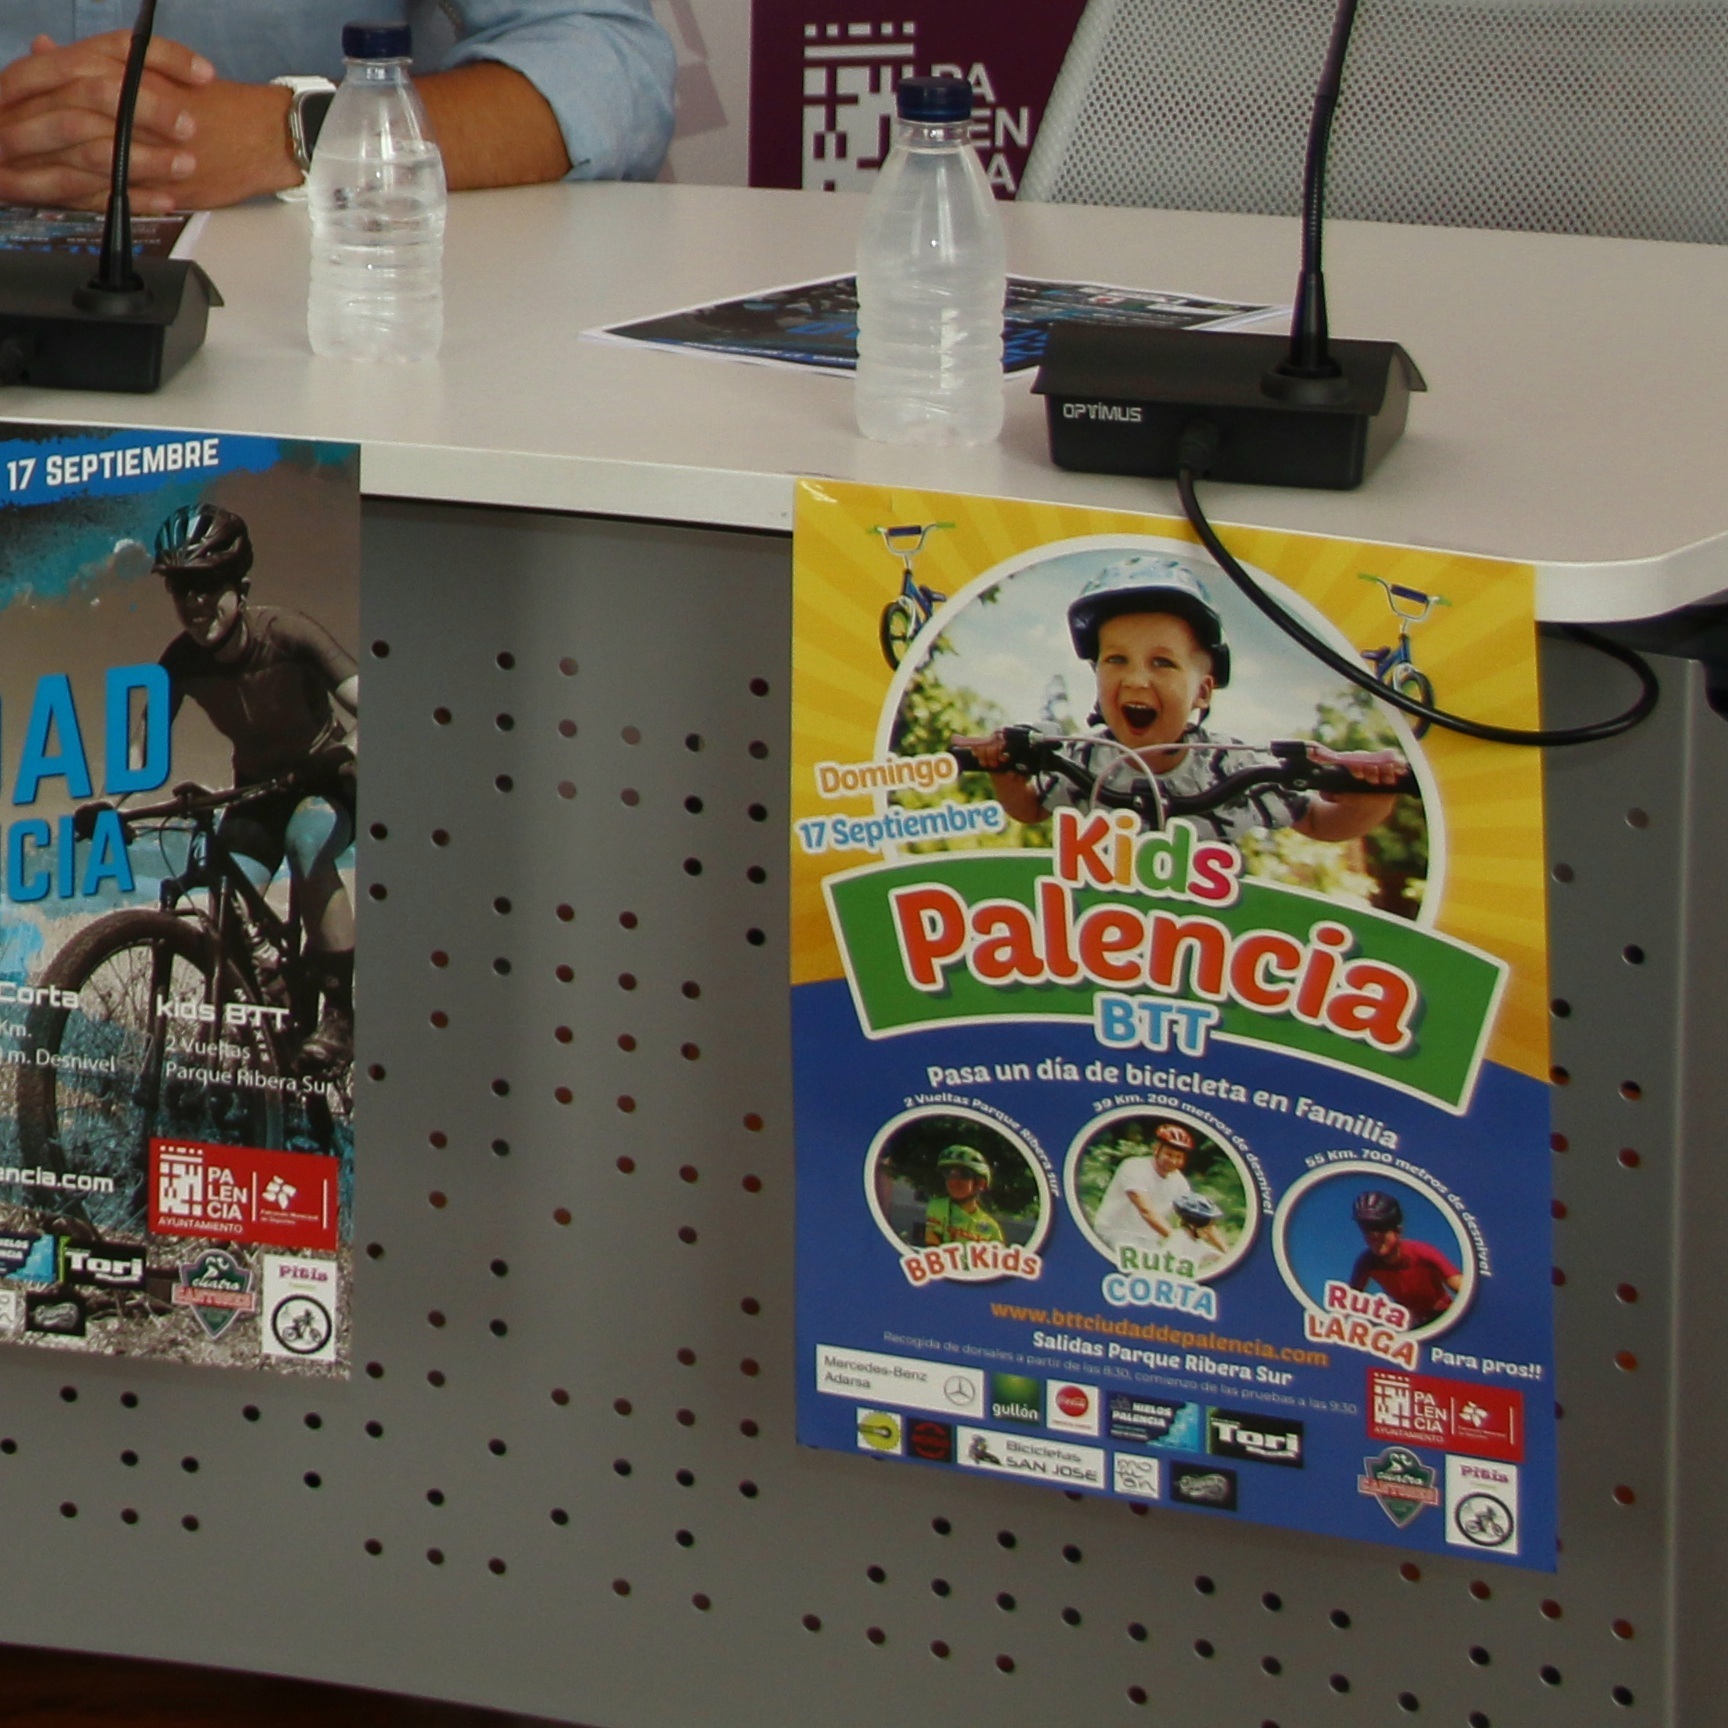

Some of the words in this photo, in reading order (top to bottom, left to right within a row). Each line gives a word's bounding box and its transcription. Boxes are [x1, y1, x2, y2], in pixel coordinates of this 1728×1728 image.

[1063, 402, 1142, 421] OPTIMUS
[7, 459, 36, 491] 17
[46, 439, 220, 487] SEPTIEMBRE
[820, 756, 953, 800] Domingo
[799, 825, 826, 849] 17
[832, 806, 999, 849] Septiembre
[1059, 814, 1236, 899] Kids
[895, 884, 1410, 1046] Palencia
[156, 993, 215, 1022] kids
[226, 1003, 290, 1029] BTT
[1103, 1003, 1211, 1051] BTT
[36, 1049, 115, 1072] Desnivel
[166, 1061, 232, 1088] Parque
[237, 1071, 296, 1092] Ribera
[927, 1066, 990, 1088] Pasa
[995, 1064, 1030, 1080] un
[1038, 1059, 1080, 1082] día
[1085, 1062, 1118, 1083] de
[1126, 1064, 1246, 1101] bicicleta
[1253, 1089, 1287, 1111] en
[1295, 1097, 1399, 1149] Familia
[208, 1167, 234, 1185] PA
[207, 1185, 247, 1204] LEN
[207, 1202, 242, 1220] CIA
[158, 1217, 243, 1234] AYUNTAMIENTO
[905, 1249, 960, 1282] BBT
[971, 1246, 1038, 1276] Kids
[1120, 1246, 1195, 1277] Ruta
[1106, 1279, 1215, 1315] CORTA
[1328, 1284, 1406, 1327] Ruta
[1308, 1314, 1417, 1366] LARGA
[1033, 1332, 1103, 1358] Salidas
[1109, 1342, 1181, 1372] Parque
[1186, 1351, 1252, 1380] Ribera
[1256, 1363, 1292, 1386] Sur
[1431, 1347, 1478, 1370] Para
[1482, 1358, 1542, 1380] pros!!
[1414, 1406, 1445, 1420] LEN
[1414, 1418, 1443, 1432] CIA
